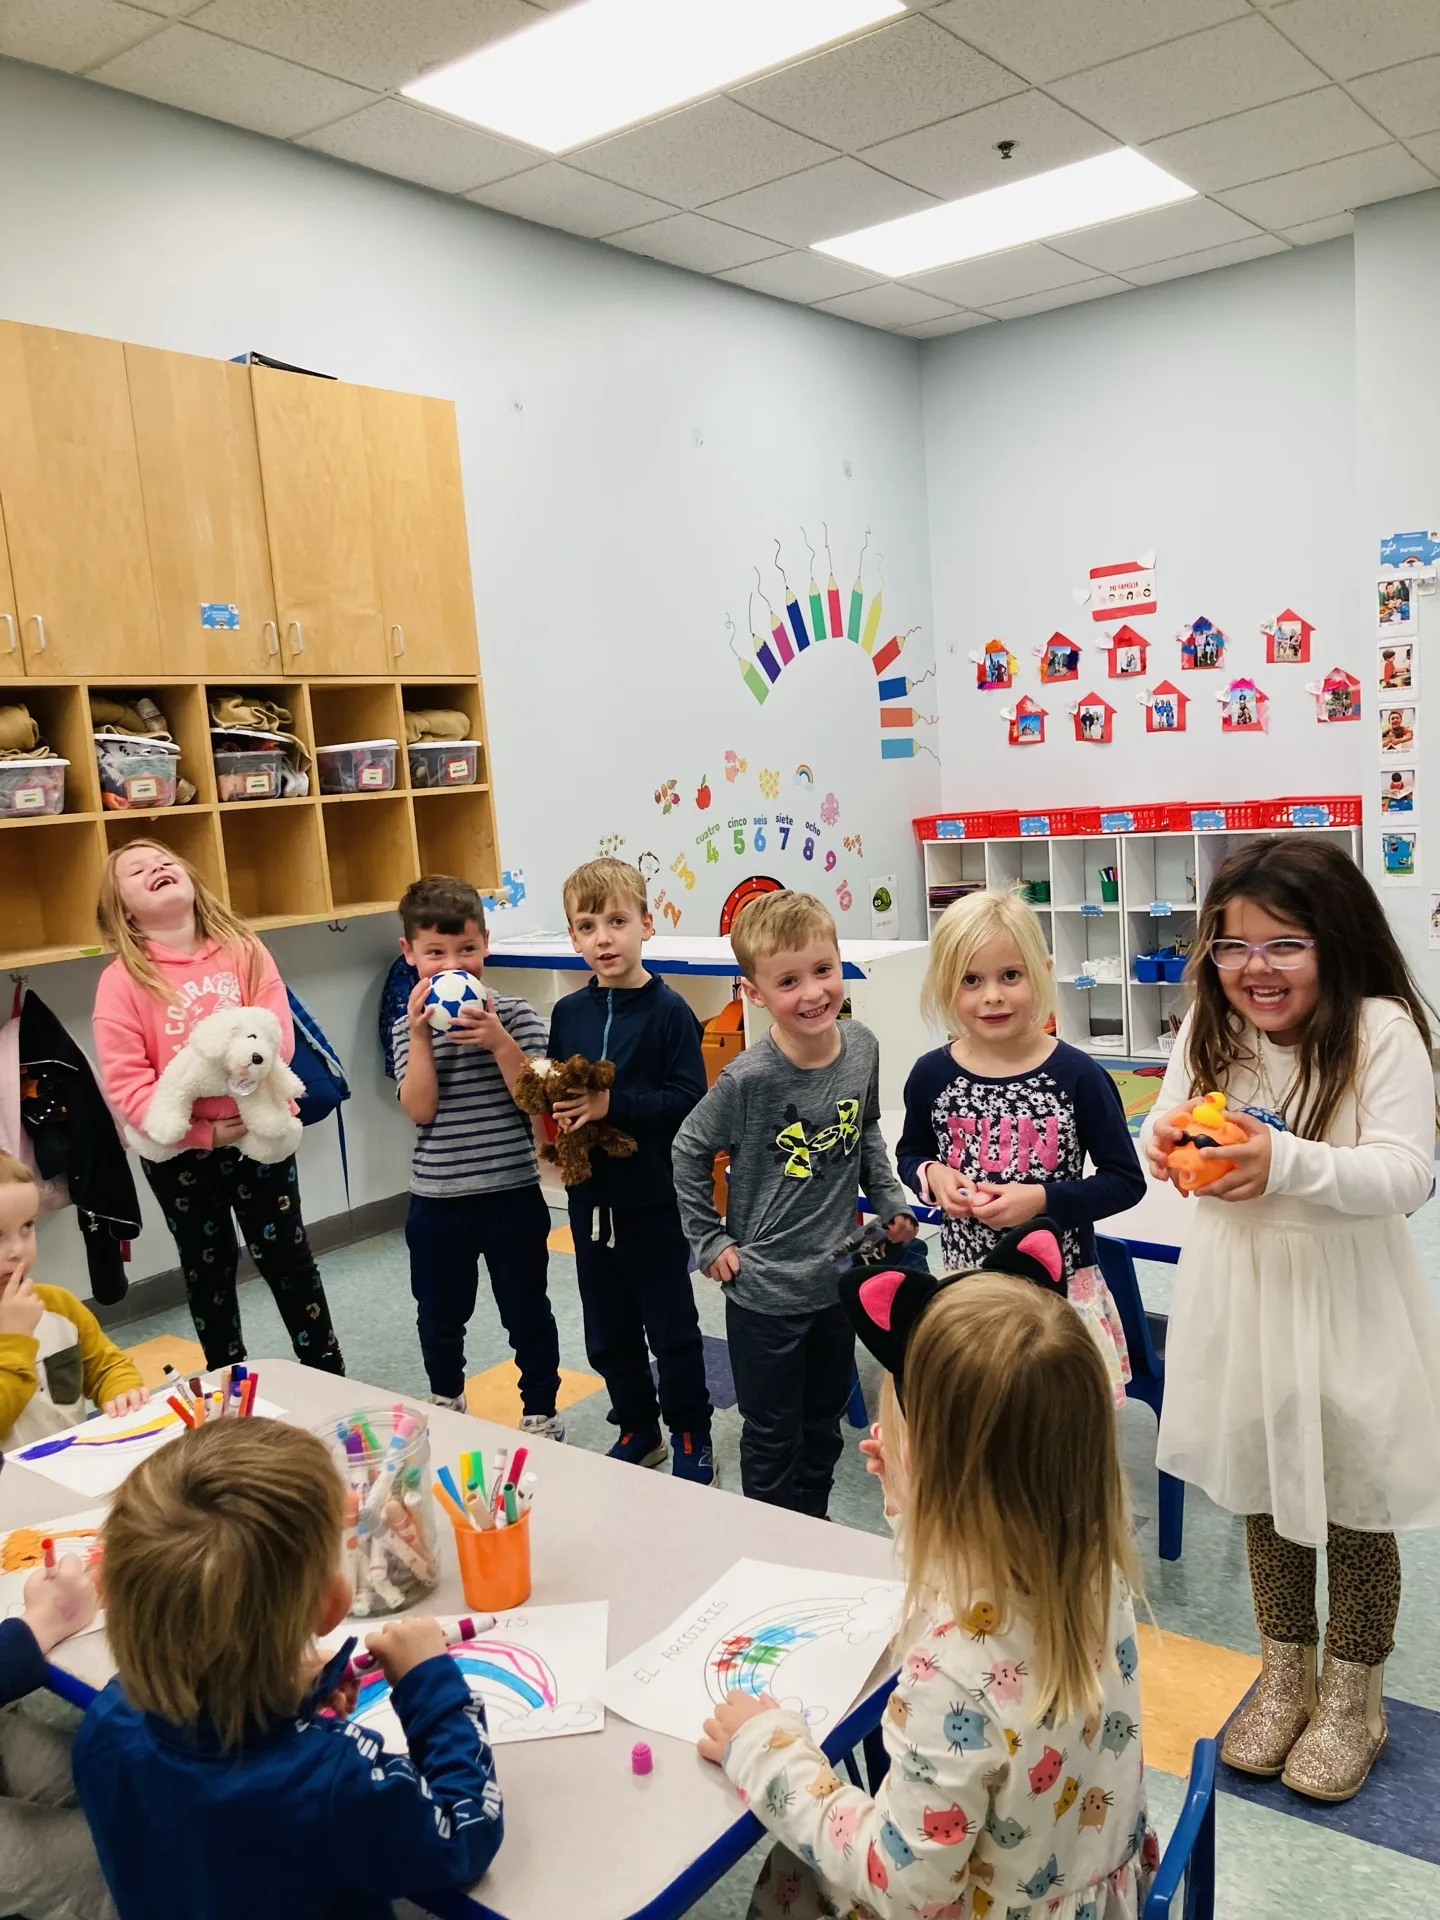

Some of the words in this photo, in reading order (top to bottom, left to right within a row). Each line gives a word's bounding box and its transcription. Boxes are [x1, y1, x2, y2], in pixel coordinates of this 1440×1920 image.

[1117, 581, 1139, 590] FAMILIA
[727, 816, 748, 829] cinco
[753, 813, 767, 826] seis
[775, 812, 793, 826] siete
[805, 821, 821, 836] ocho
[695, 823, 720, 845] cuatro
[733, 828, 746, 855] 5
[754, 827, 767, 853] 6
[779, 826, 791, 851] 7
[706, 839, 720, 864] 4
[803, 836, 815, 861] 8
[824, 850, 837, 872] 9
[677, 862, 696, 890] 3
[653, 888, 667, 910] dos
[835, 879, 853, 912] 10
[663, 901, 683, 929] 2
[165, 976, 241, 1035] COURAGE
[947, 1117, 1058, 1172] FUN
[633, 1666, 661, 1685] EL
[660, 1599, 730, 1662] ARCOIRIS
